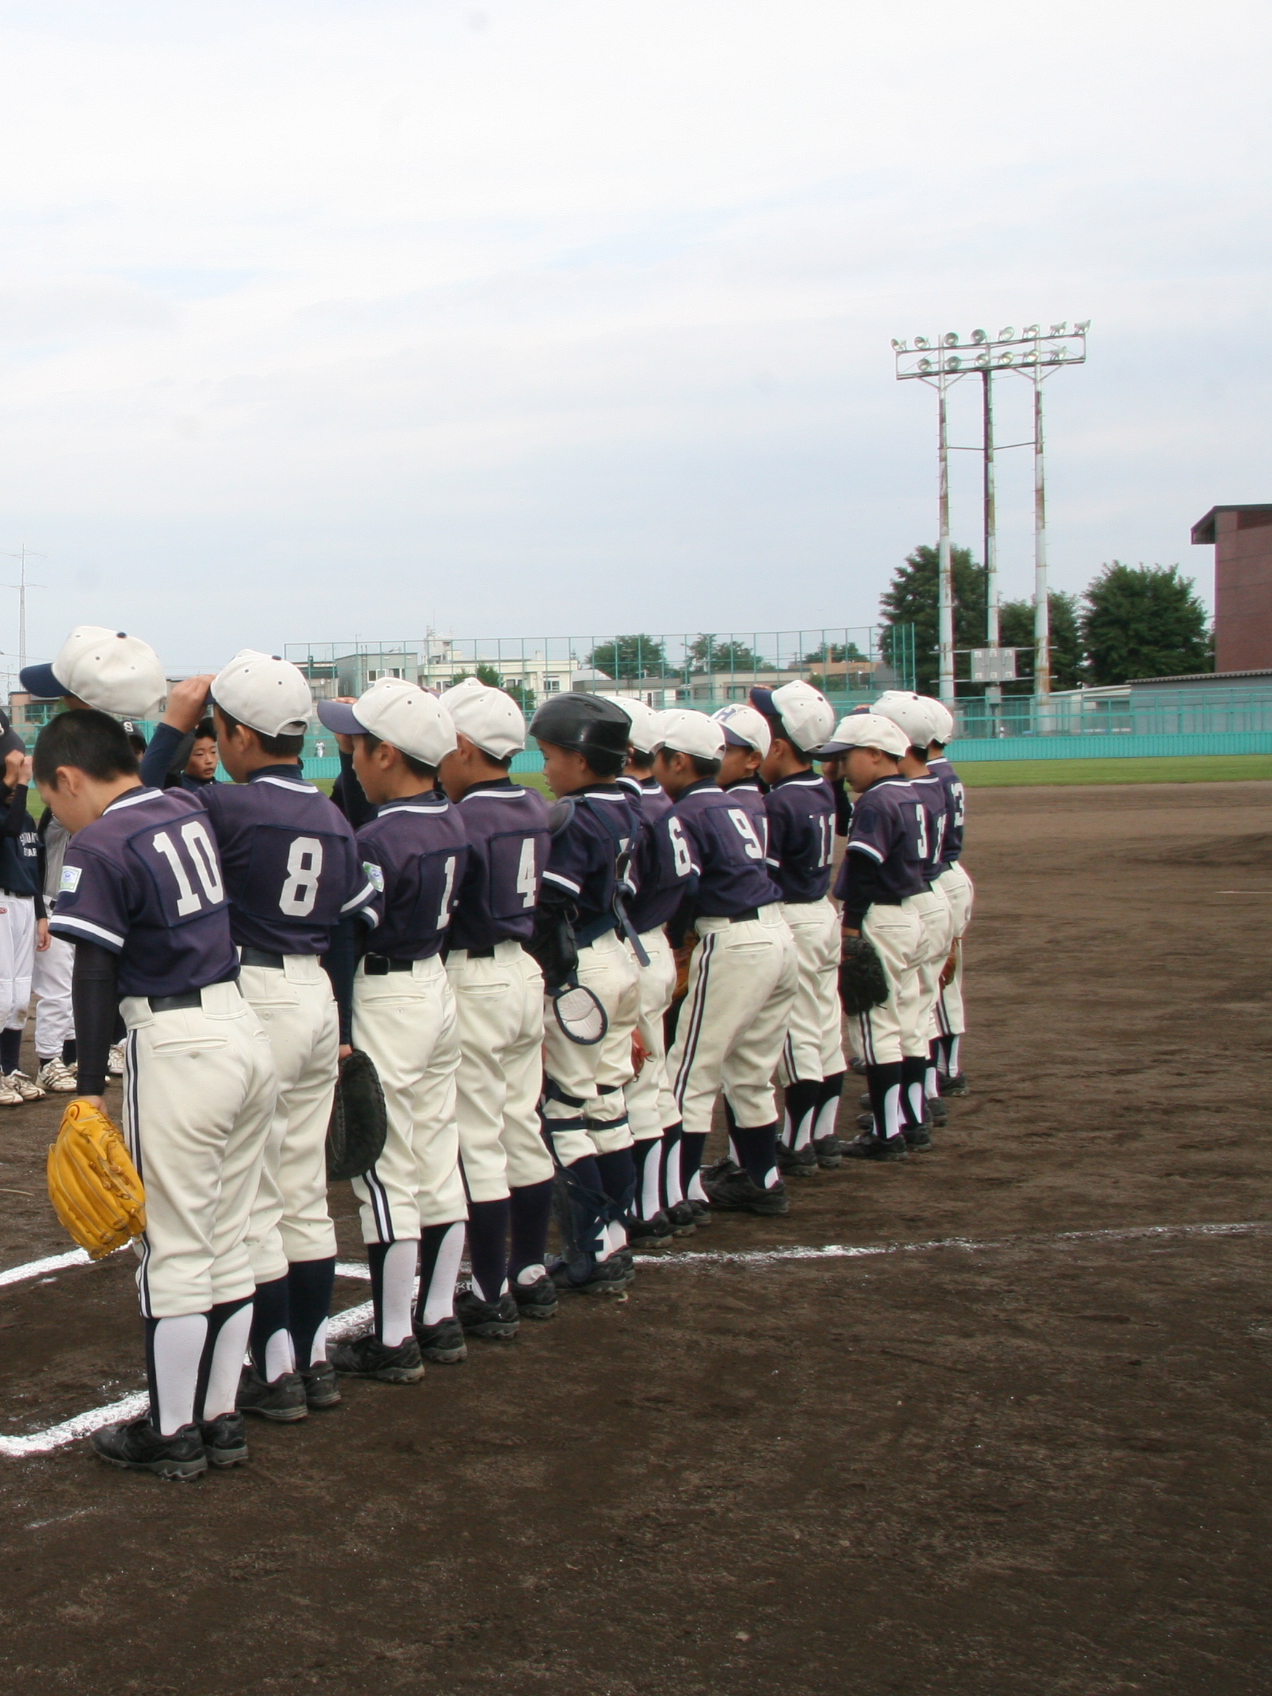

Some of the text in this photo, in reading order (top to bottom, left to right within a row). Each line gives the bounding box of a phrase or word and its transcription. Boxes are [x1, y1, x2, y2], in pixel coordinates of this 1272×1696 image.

[123, 721, 134, 732] S
[152, 820, 224, 917] 10
[668, 816, 692, 877] 6
[728, 809, 763, 859] 9
[278, 836, 323, 916] 8
[435, 856, 456, 930] 1
[516, 838, 536, 908] 4
